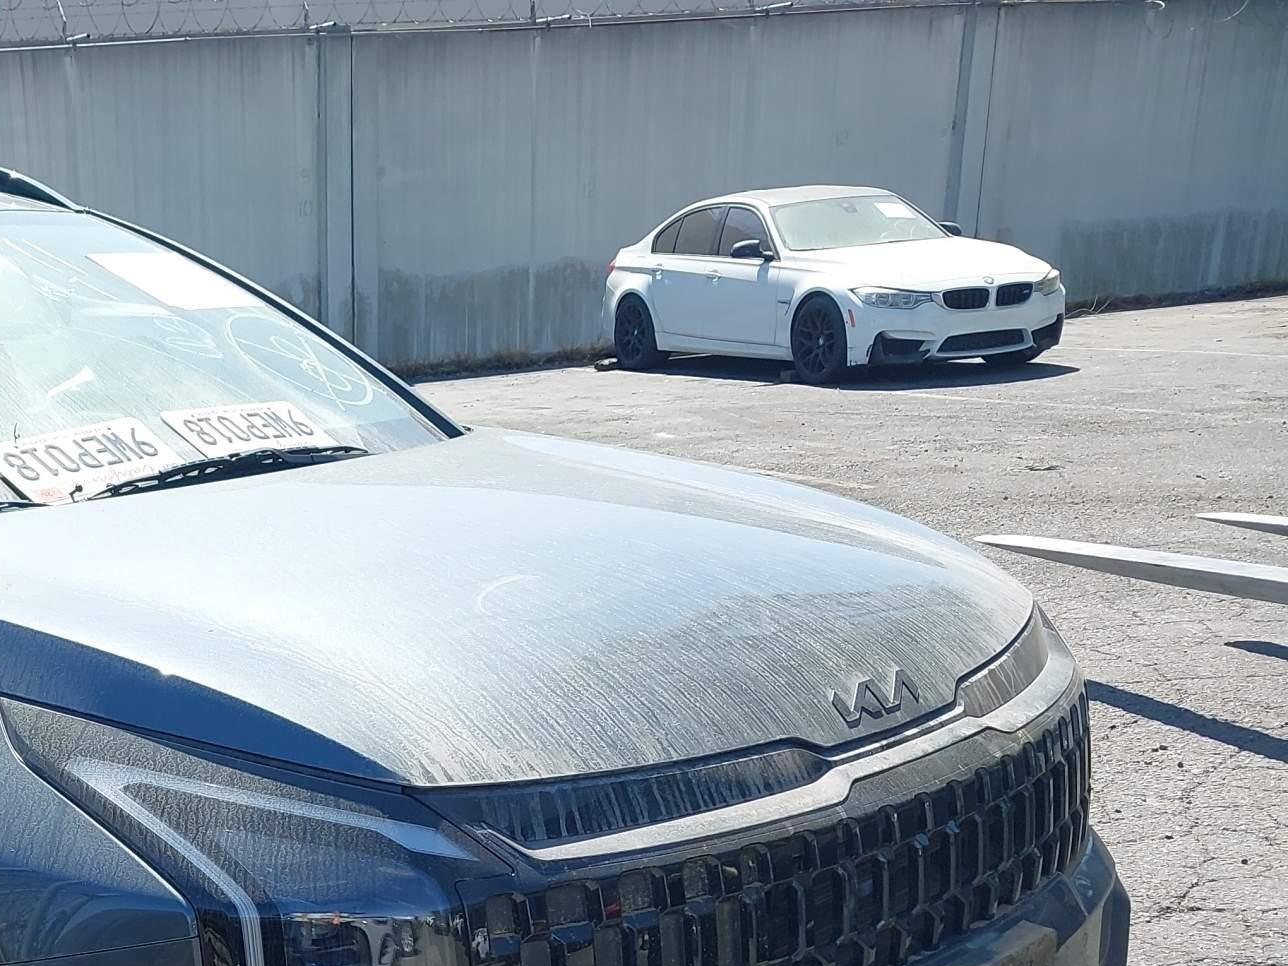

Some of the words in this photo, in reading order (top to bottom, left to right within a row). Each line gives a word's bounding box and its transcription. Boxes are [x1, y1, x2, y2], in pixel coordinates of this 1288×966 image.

[3, 427, 159, 481] 9WEP018
[188, 409, 315, 447] 9WEP018
[830, 666, 920, 729] KIA
